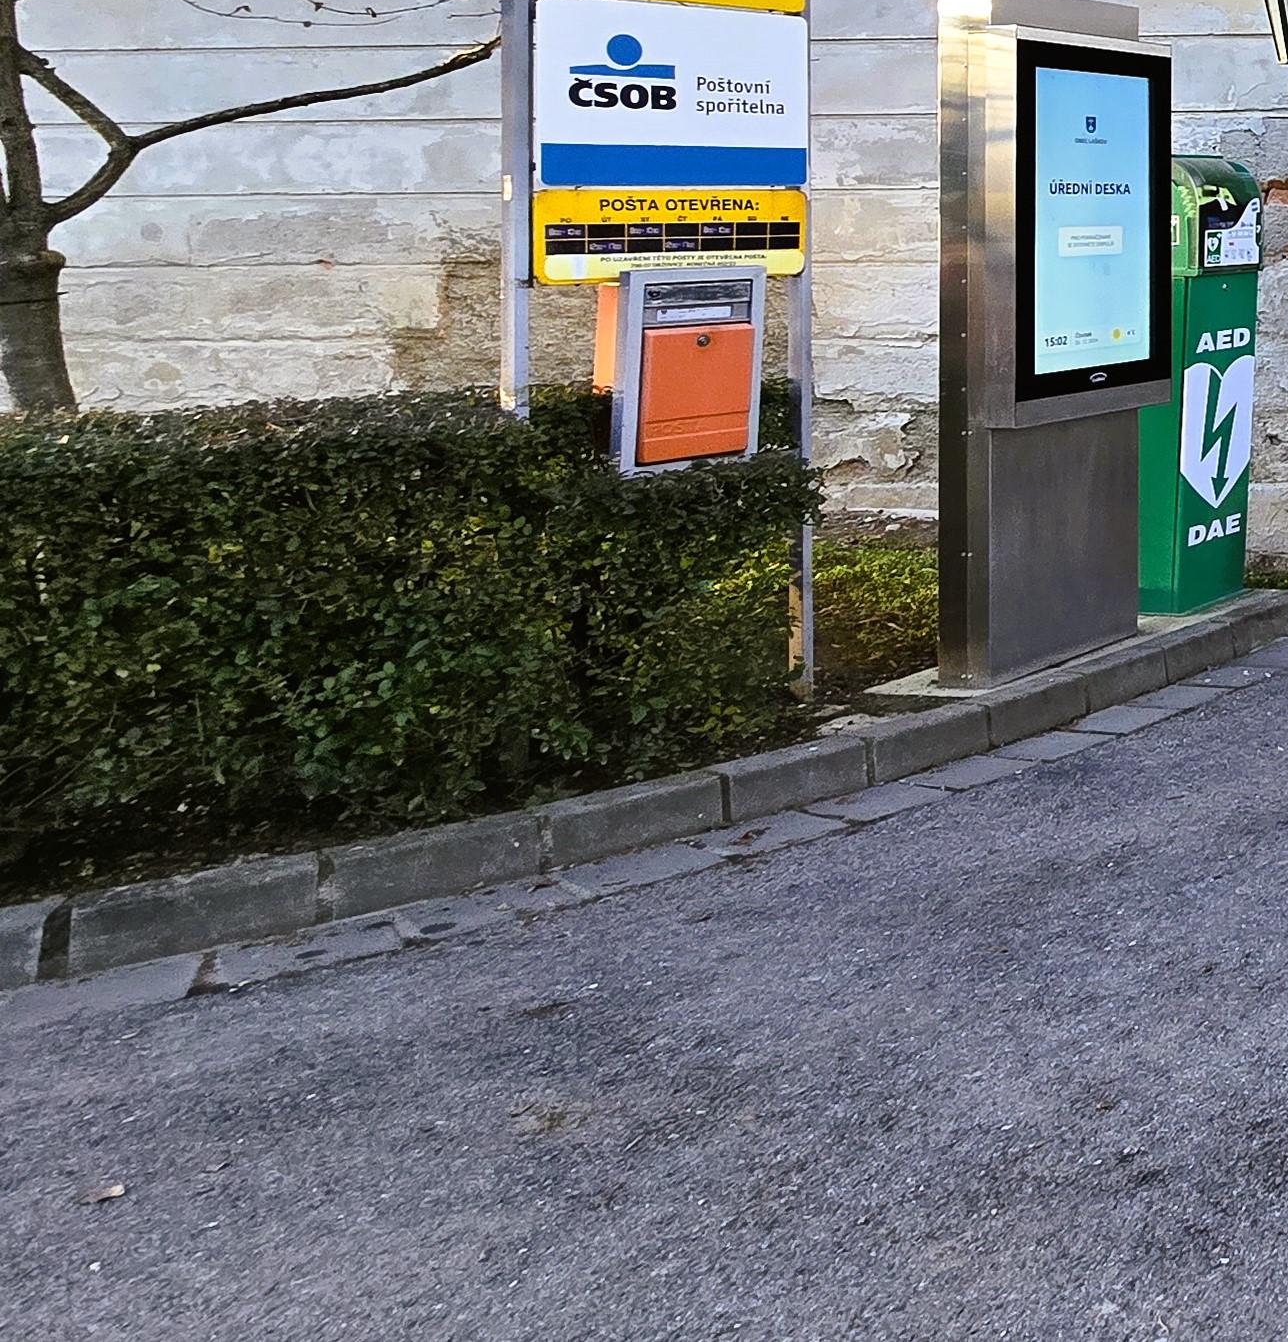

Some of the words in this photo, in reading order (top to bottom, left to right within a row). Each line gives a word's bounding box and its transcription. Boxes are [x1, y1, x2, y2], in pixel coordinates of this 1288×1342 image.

[568, 77, 677, 110] ČSOB
[696, 76, 771, 95] Poštovní
[696, 98, 785, 116] spořitelna
[1050, 178, 1093, 195] ÚŘEDNÍ
[1095, 183, 1131, 195] DESKA
[599, 196, 660, 212] POŠTA
[665, 195, 760, 212] OTEVŘENA:
[1044, 335, 1068, 347] 15:02
[1195, 327, 1251, 354] AED
[1187, 512, 1242, 547] DAE
